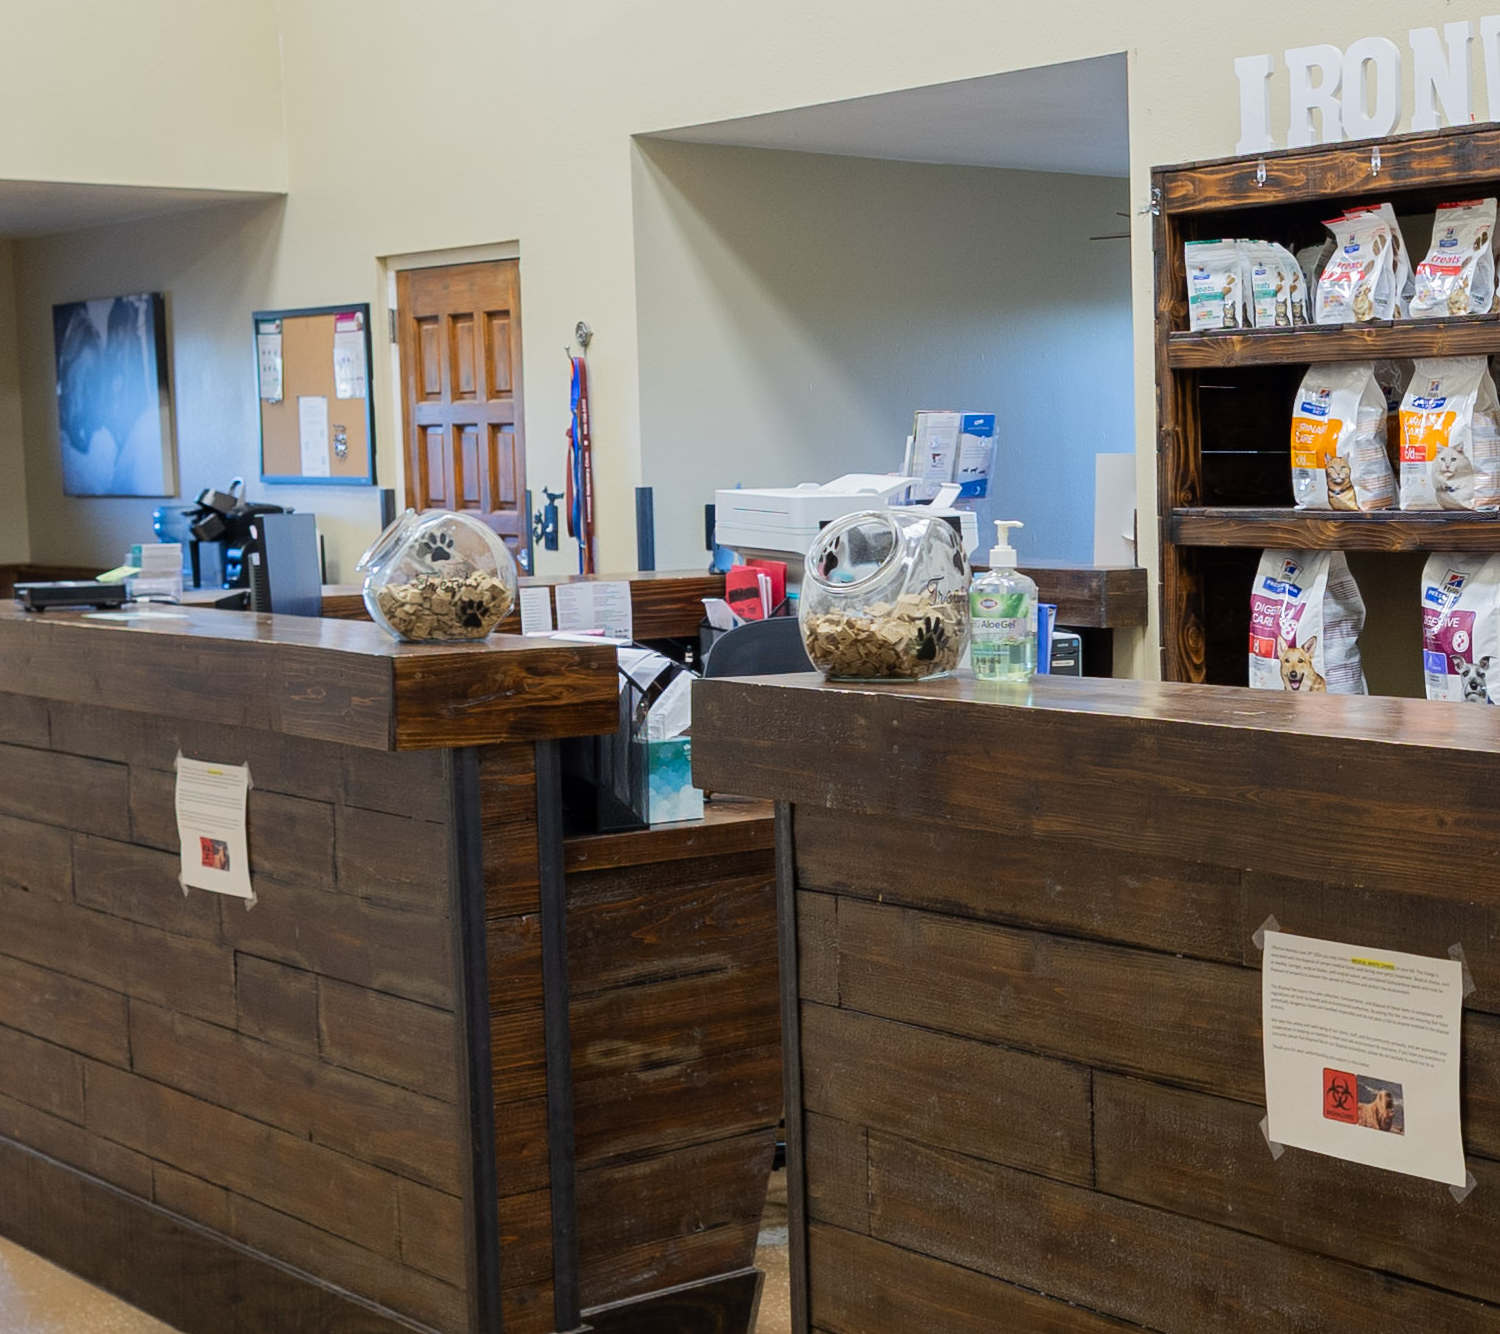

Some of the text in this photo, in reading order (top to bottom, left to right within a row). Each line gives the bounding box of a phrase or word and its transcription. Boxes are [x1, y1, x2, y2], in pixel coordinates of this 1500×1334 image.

[1431, 255, 1461, 264] treats
[982, 620, 1016, 629] Aloe Gel
